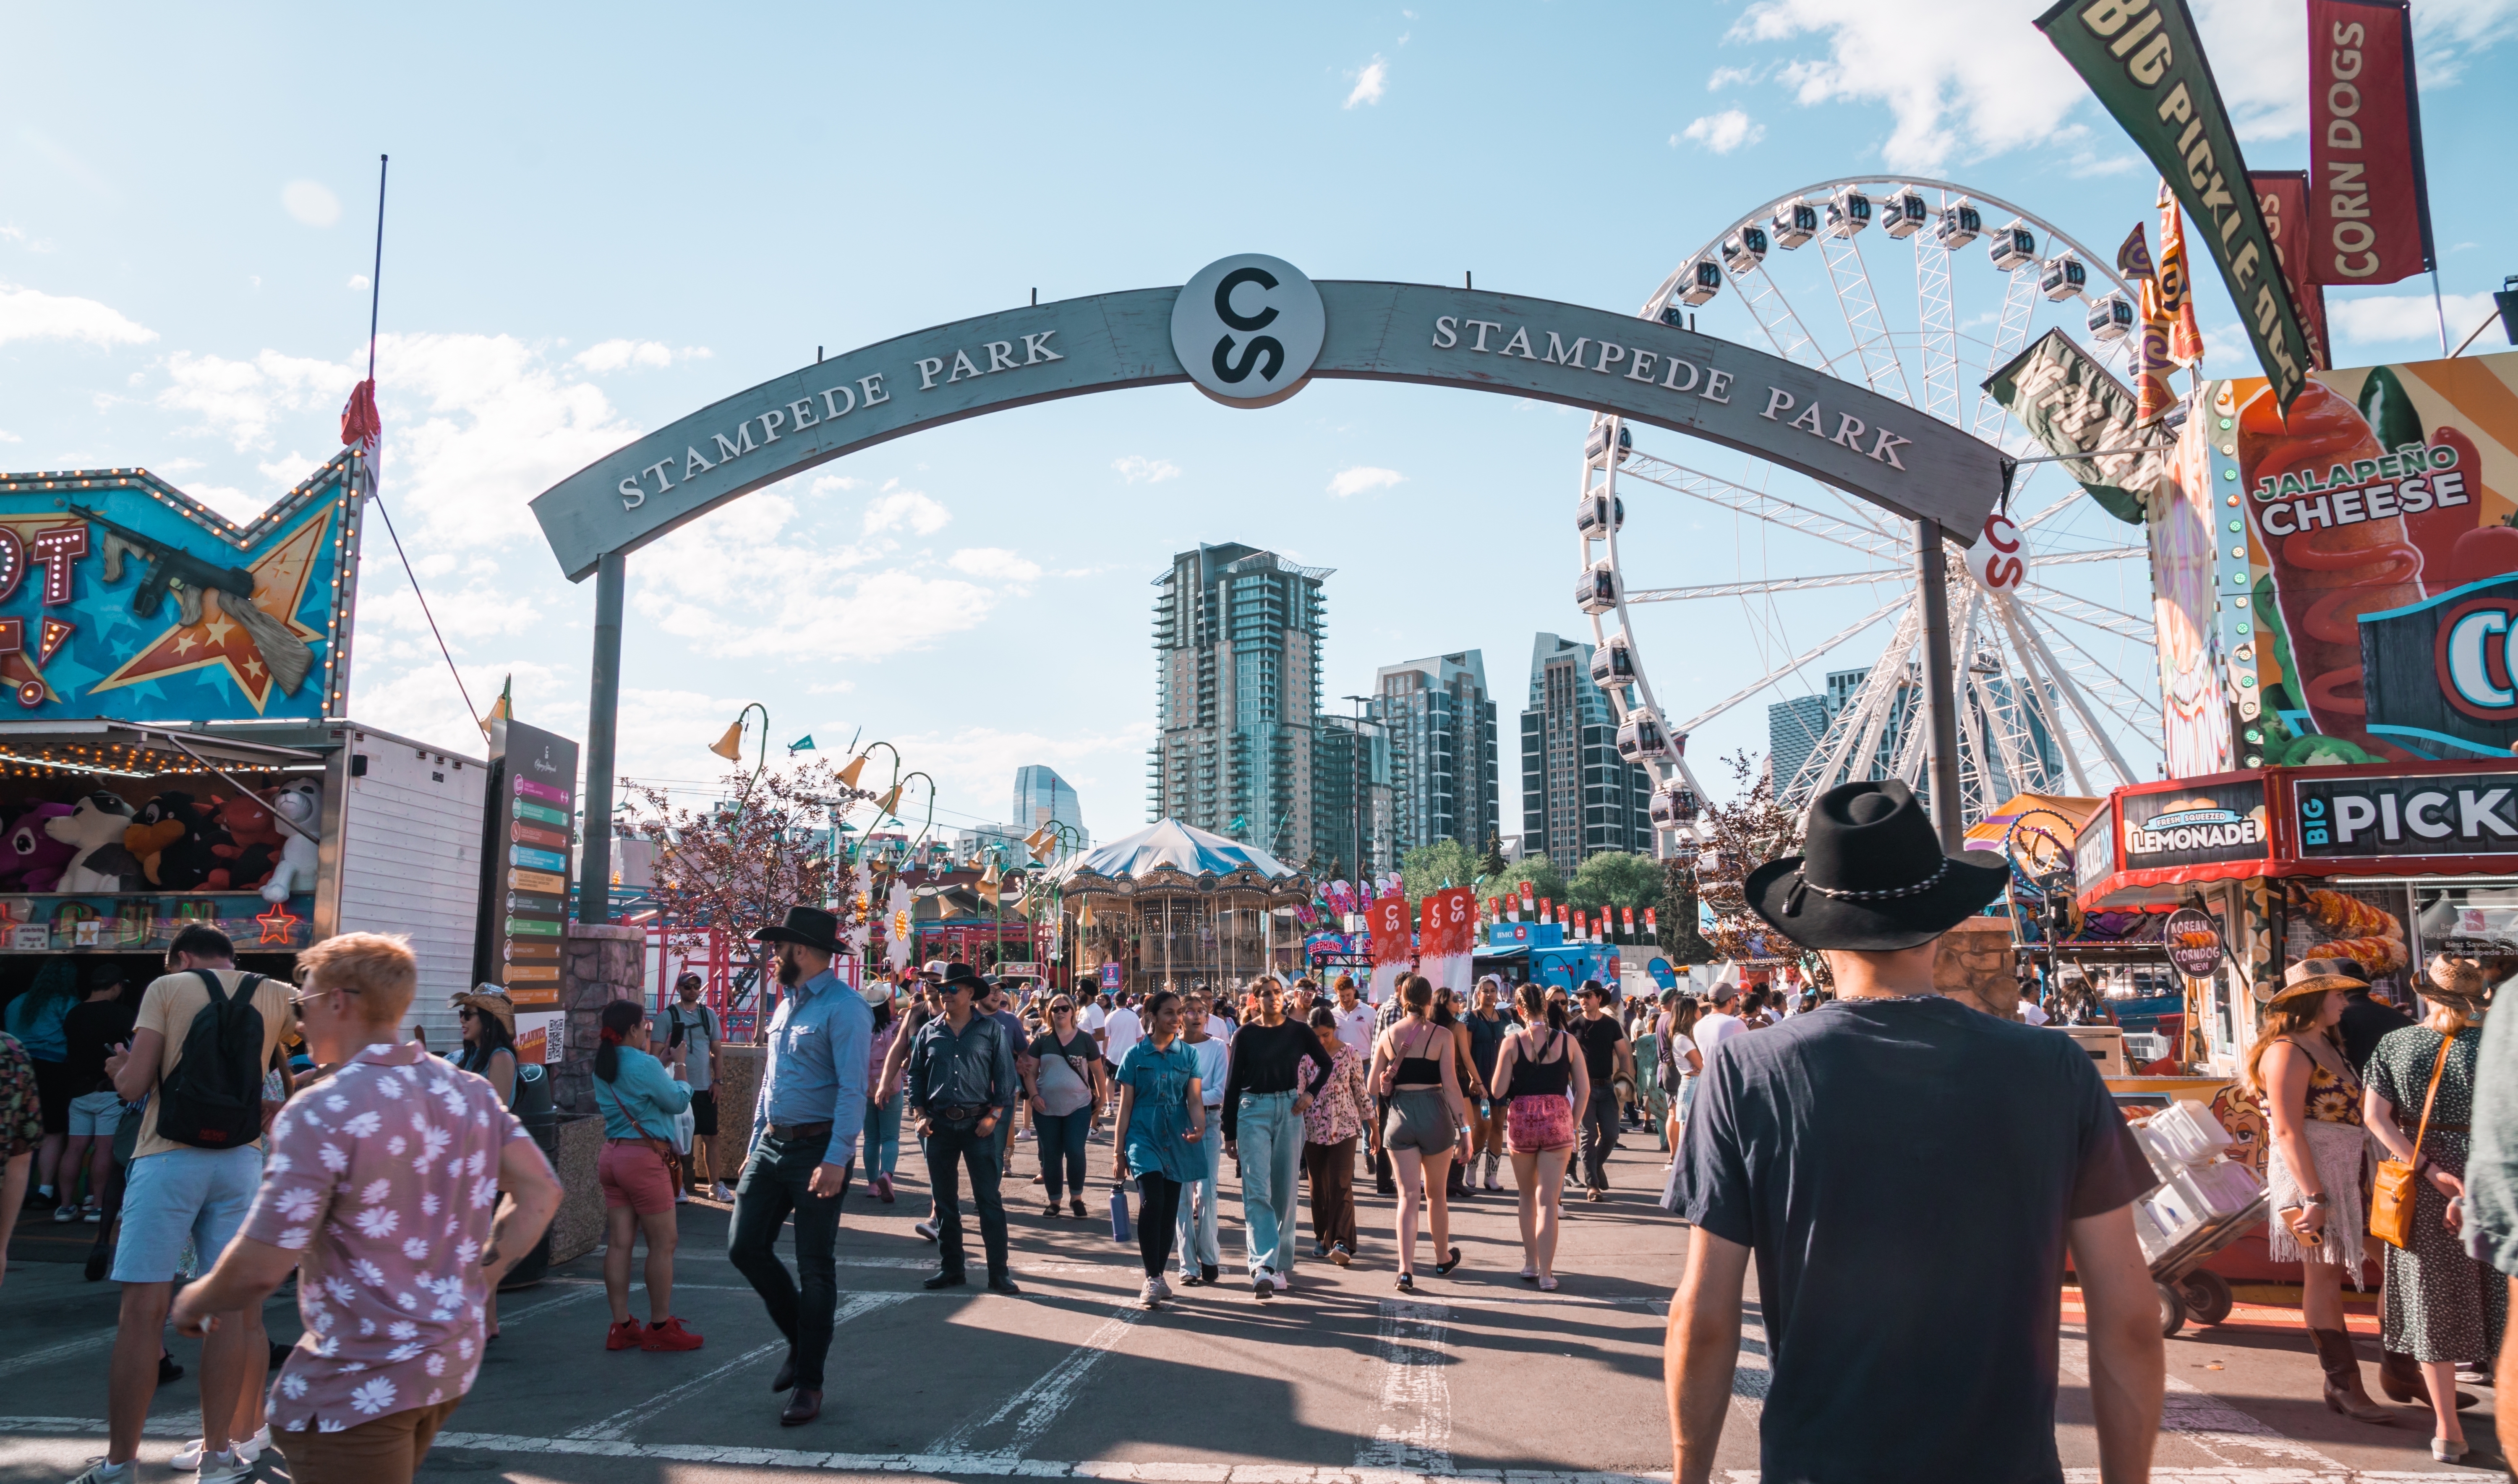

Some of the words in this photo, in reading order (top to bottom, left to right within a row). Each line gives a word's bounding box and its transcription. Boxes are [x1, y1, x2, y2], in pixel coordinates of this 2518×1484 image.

[2328, 20, 2364, 150] DOGS
[2080, 0, 2174, 80] BIG
[2158, 82, 2258, 292] PICKLE
[2329, 162, 2380, 279] CORN
[1212, 267, 1284, 384] CS
[618, 371, 890, 511] STAMPEDE
[914, 329, 1063, 389] PARK
[1432, 316, 1734, 404] STAMPEDE
[1759, 387, 1911, 471] PARK
[2254, 442, 2458, 501] JALAPEÑO
[2261, 472, 2468, 536] CHEESE
[1984, 514, 2023, 588] CS
[2132, 822, 2255, 854] LEMONADE
[2157, 815, 2181, 827] FRESH
[2184, 813, 2225, 823] SQUEEZED
[2303, 799, 2328, 845] BIG
[2333, 789, 2518, 842] PICK
[2081, 833, 2101, 883] PICKLE
[1385, 904, 1400, 931] CS
[1451, 895, 1465, 922] CS
[2171, 920, 2207, 934] KOREAN
[1308, 940, 1342, 954] ELEPHANT
[2175, 947, 2220, 962] CORNDOG
[2190, 961, 2209, 972] NEW
[520, 1026, 546, 1045] PLANNER
